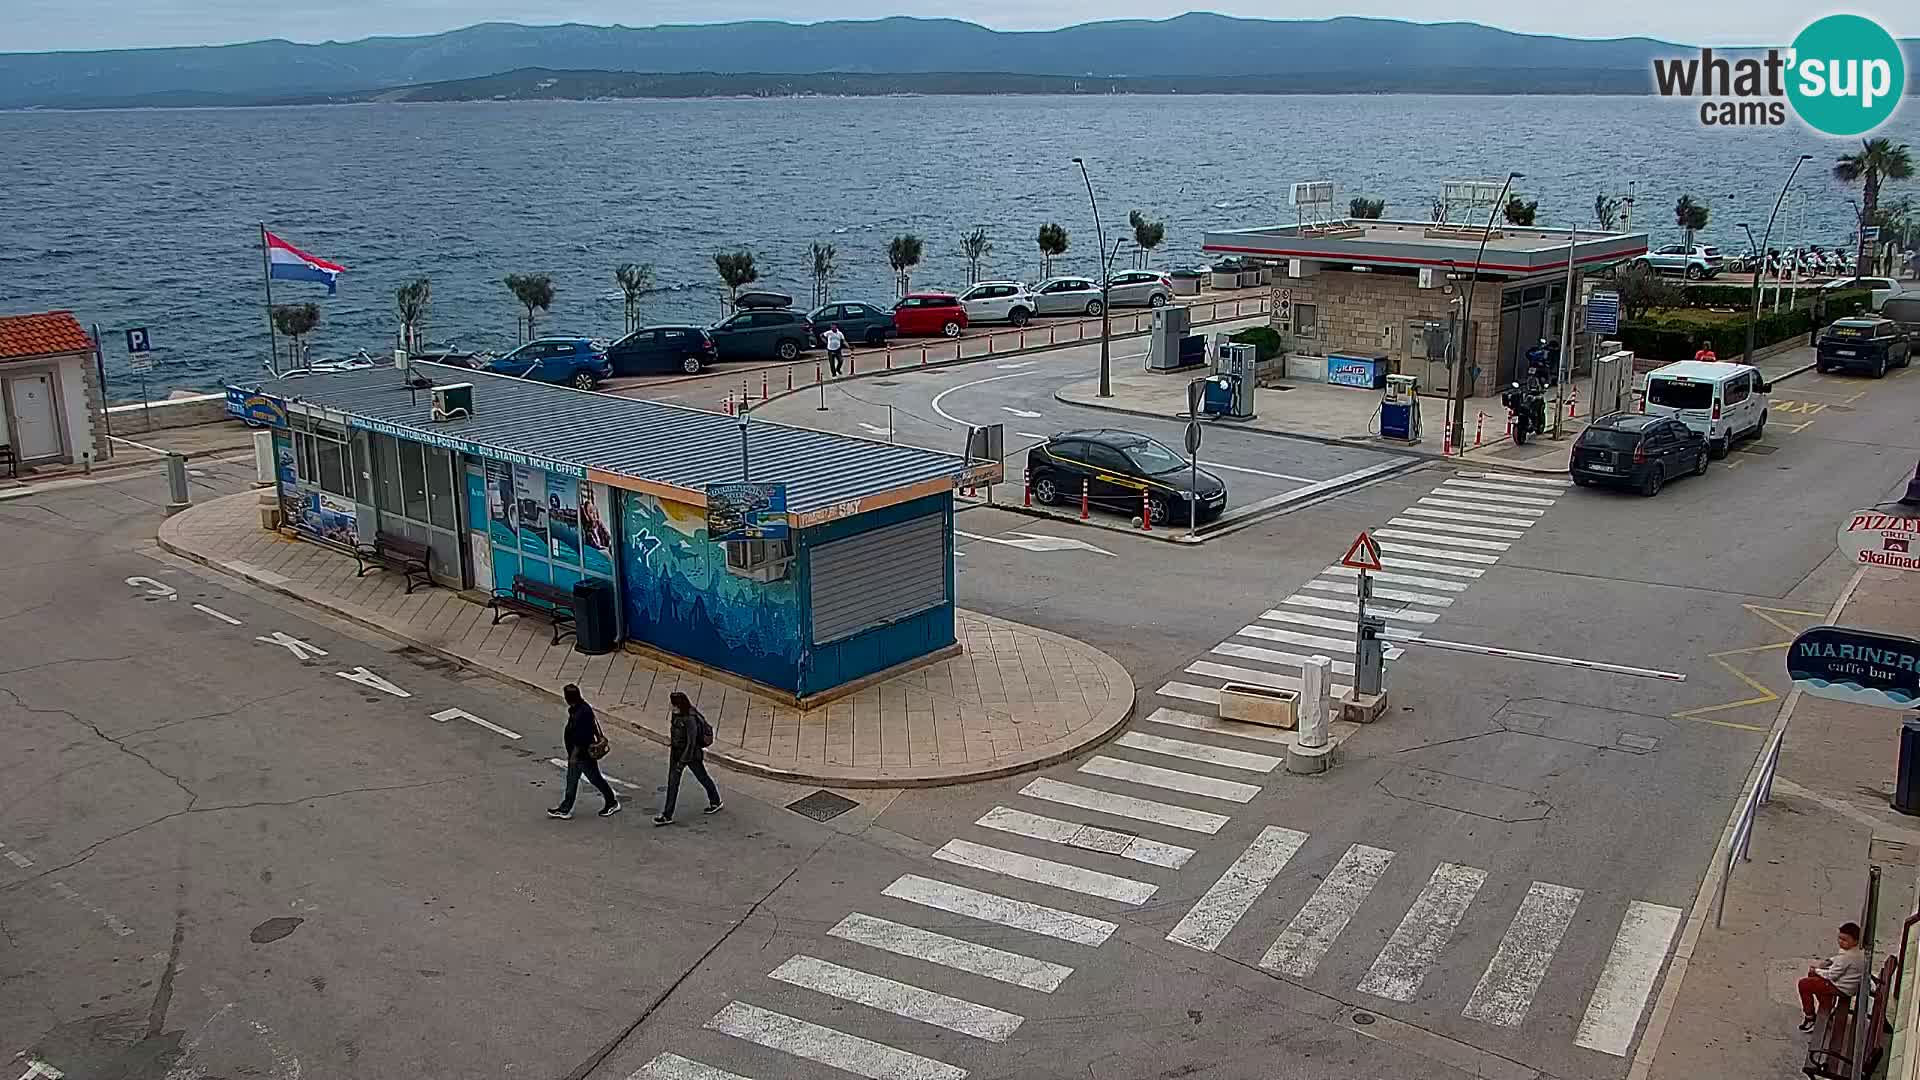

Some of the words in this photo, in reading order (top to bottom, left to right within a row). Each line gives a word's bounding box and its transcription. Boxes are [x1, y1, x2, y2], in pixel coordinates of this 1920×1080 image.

[131, 331, 144, 350] P
[396, 427, 437, 445] AUTOBUSNA
[436, 436, 469, 452] POSTAJA
[479, 445, 494, 457] BUS
[495, 449, 527, 465] STATION
[529, 457, 556, 470] TICKET
[556, 462, 583, 477] OFFICE
[1846, 515, 1920, 533] PIZZE
[1880, 530, 1917, 541] GRILL
[1828, 662, 1865, 675] caffe
[1869, 665, 1896, 681] bar
